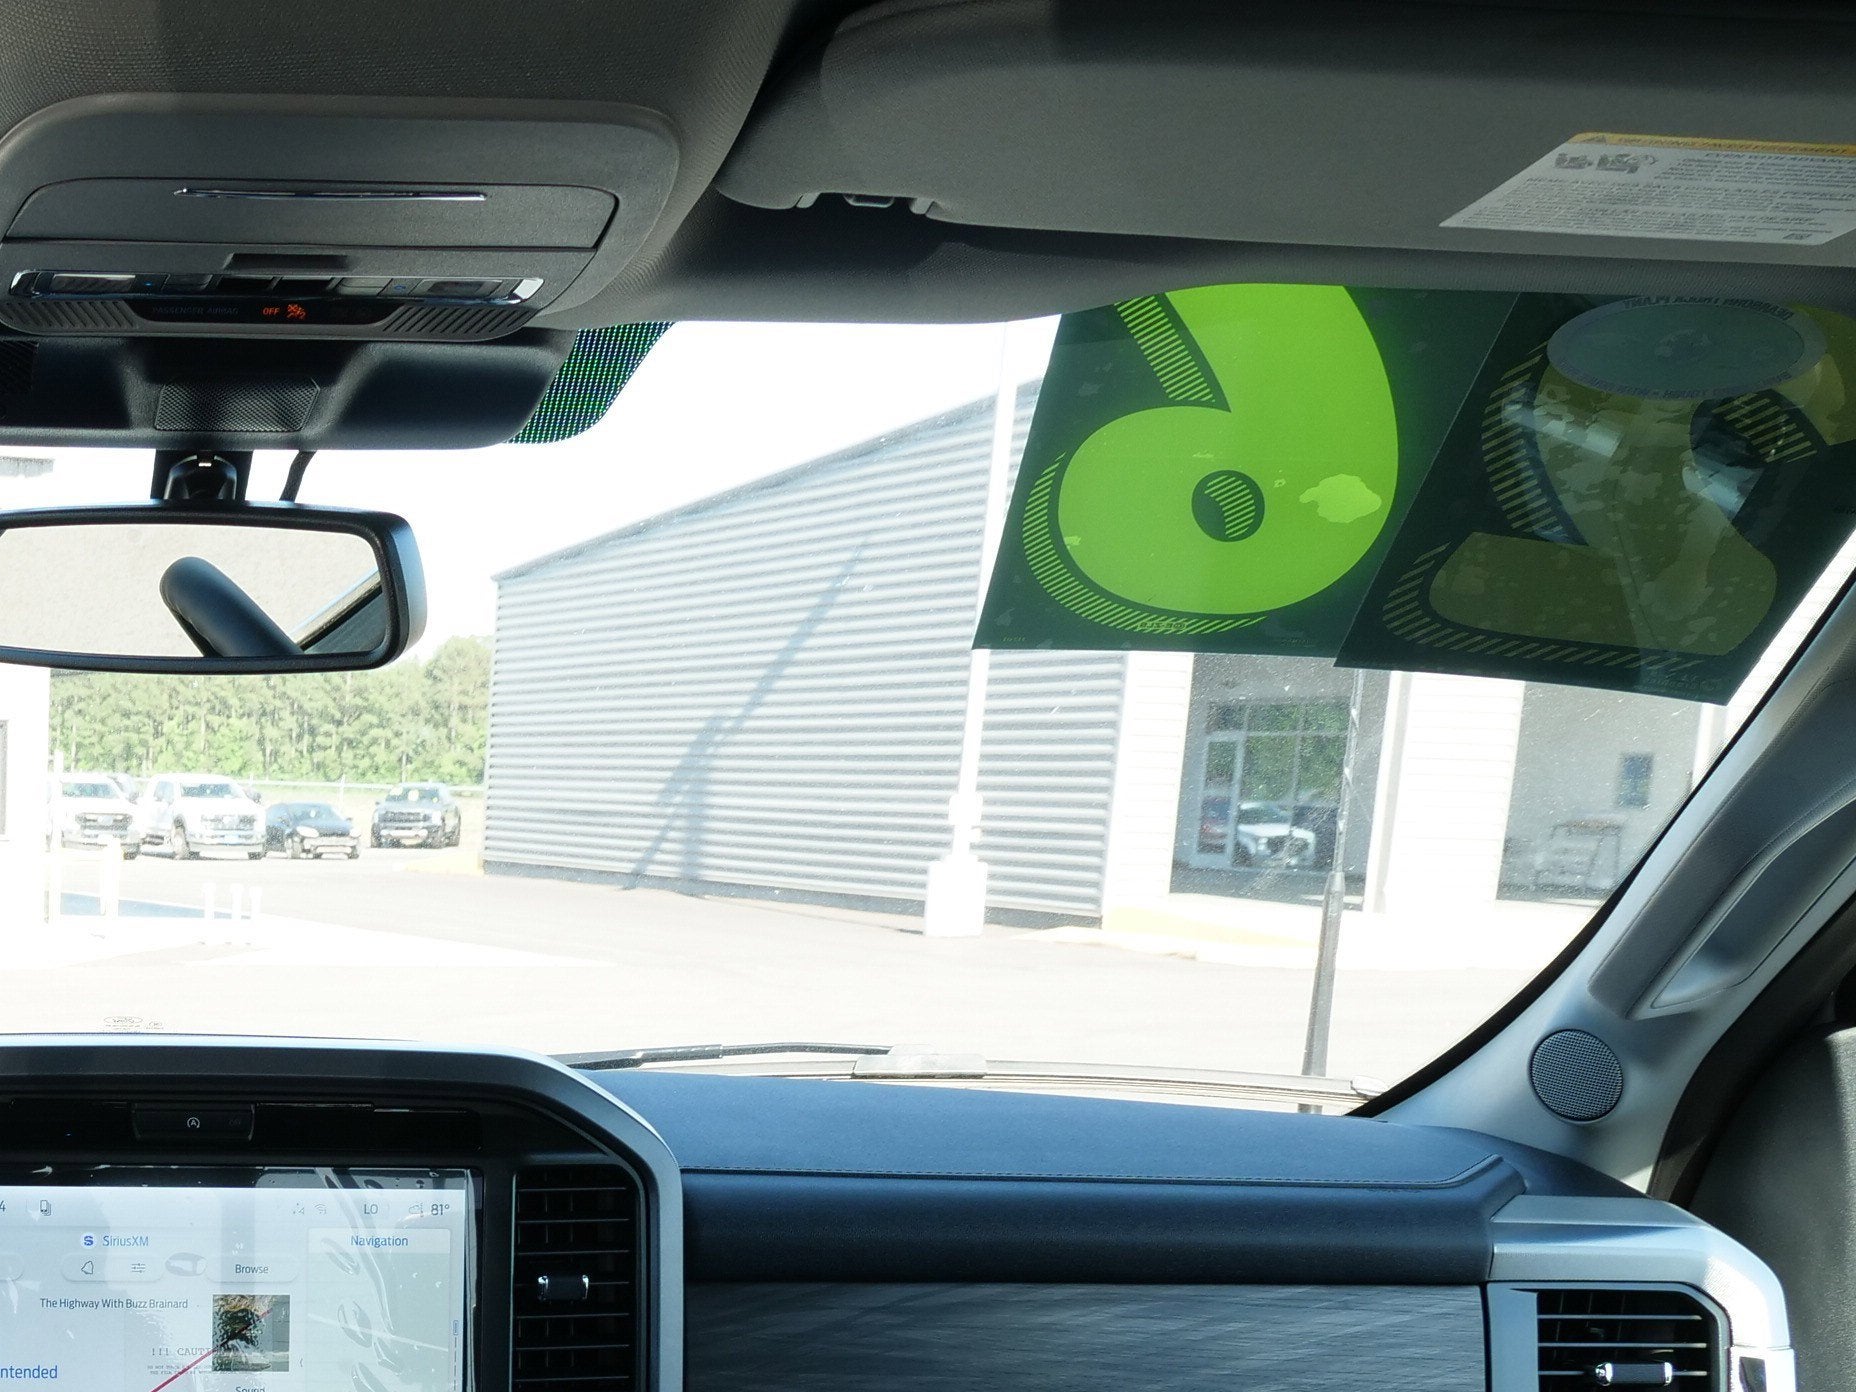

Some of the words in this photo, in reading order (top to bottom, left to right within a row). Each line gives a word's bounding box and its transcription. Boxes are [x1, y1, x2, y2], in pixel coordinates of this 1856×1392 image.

[151, 305, 204, 317] PASSENGER
[206, 306, 239, 317] AIRBAG
[262, 306, 281, 317] OFF
[363, 1203, 379, 1215] LO
[430, 1203, 451, 1216] 81°
[102, 1235, 149, 1247] SiriusXM
[350, 1235, 409, 1248] Navigation
[234, 1263, 269, 1275] Browse
[40, 1298, 57, 1309] The
[59, 1298, 100, 1310] Highway
[101, 1299, 124, 1309] With
[126, 1299, 148, 1309] Buzz
[148, 1299, 188, 1309] Brainard
